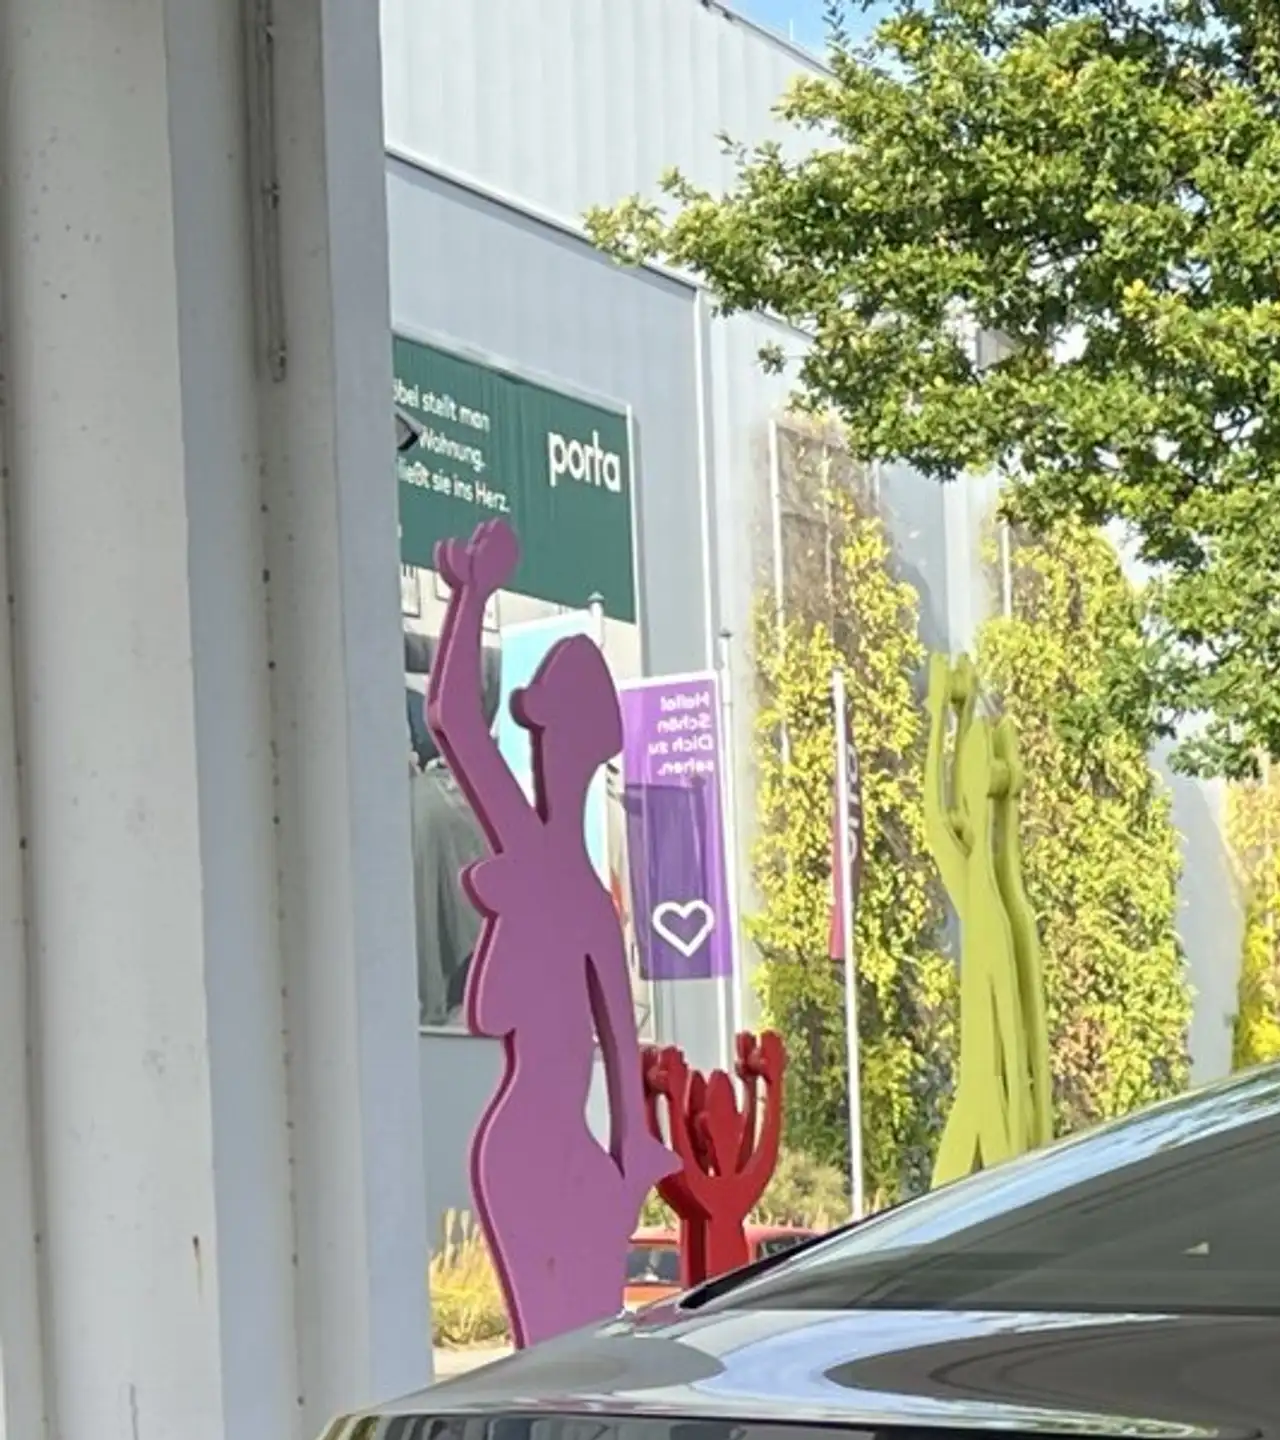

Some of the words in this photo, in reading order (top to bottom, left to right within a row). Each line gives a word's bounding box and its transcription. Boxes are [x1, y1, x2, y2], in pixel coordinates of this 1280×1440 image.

[422, 392, 457, 422] stellt
[459, 405, 491, 433] man
[548, 429, 620, 493] porta
[432, 469, 452, 495] sie
[453, 474, 474, 502] ins
